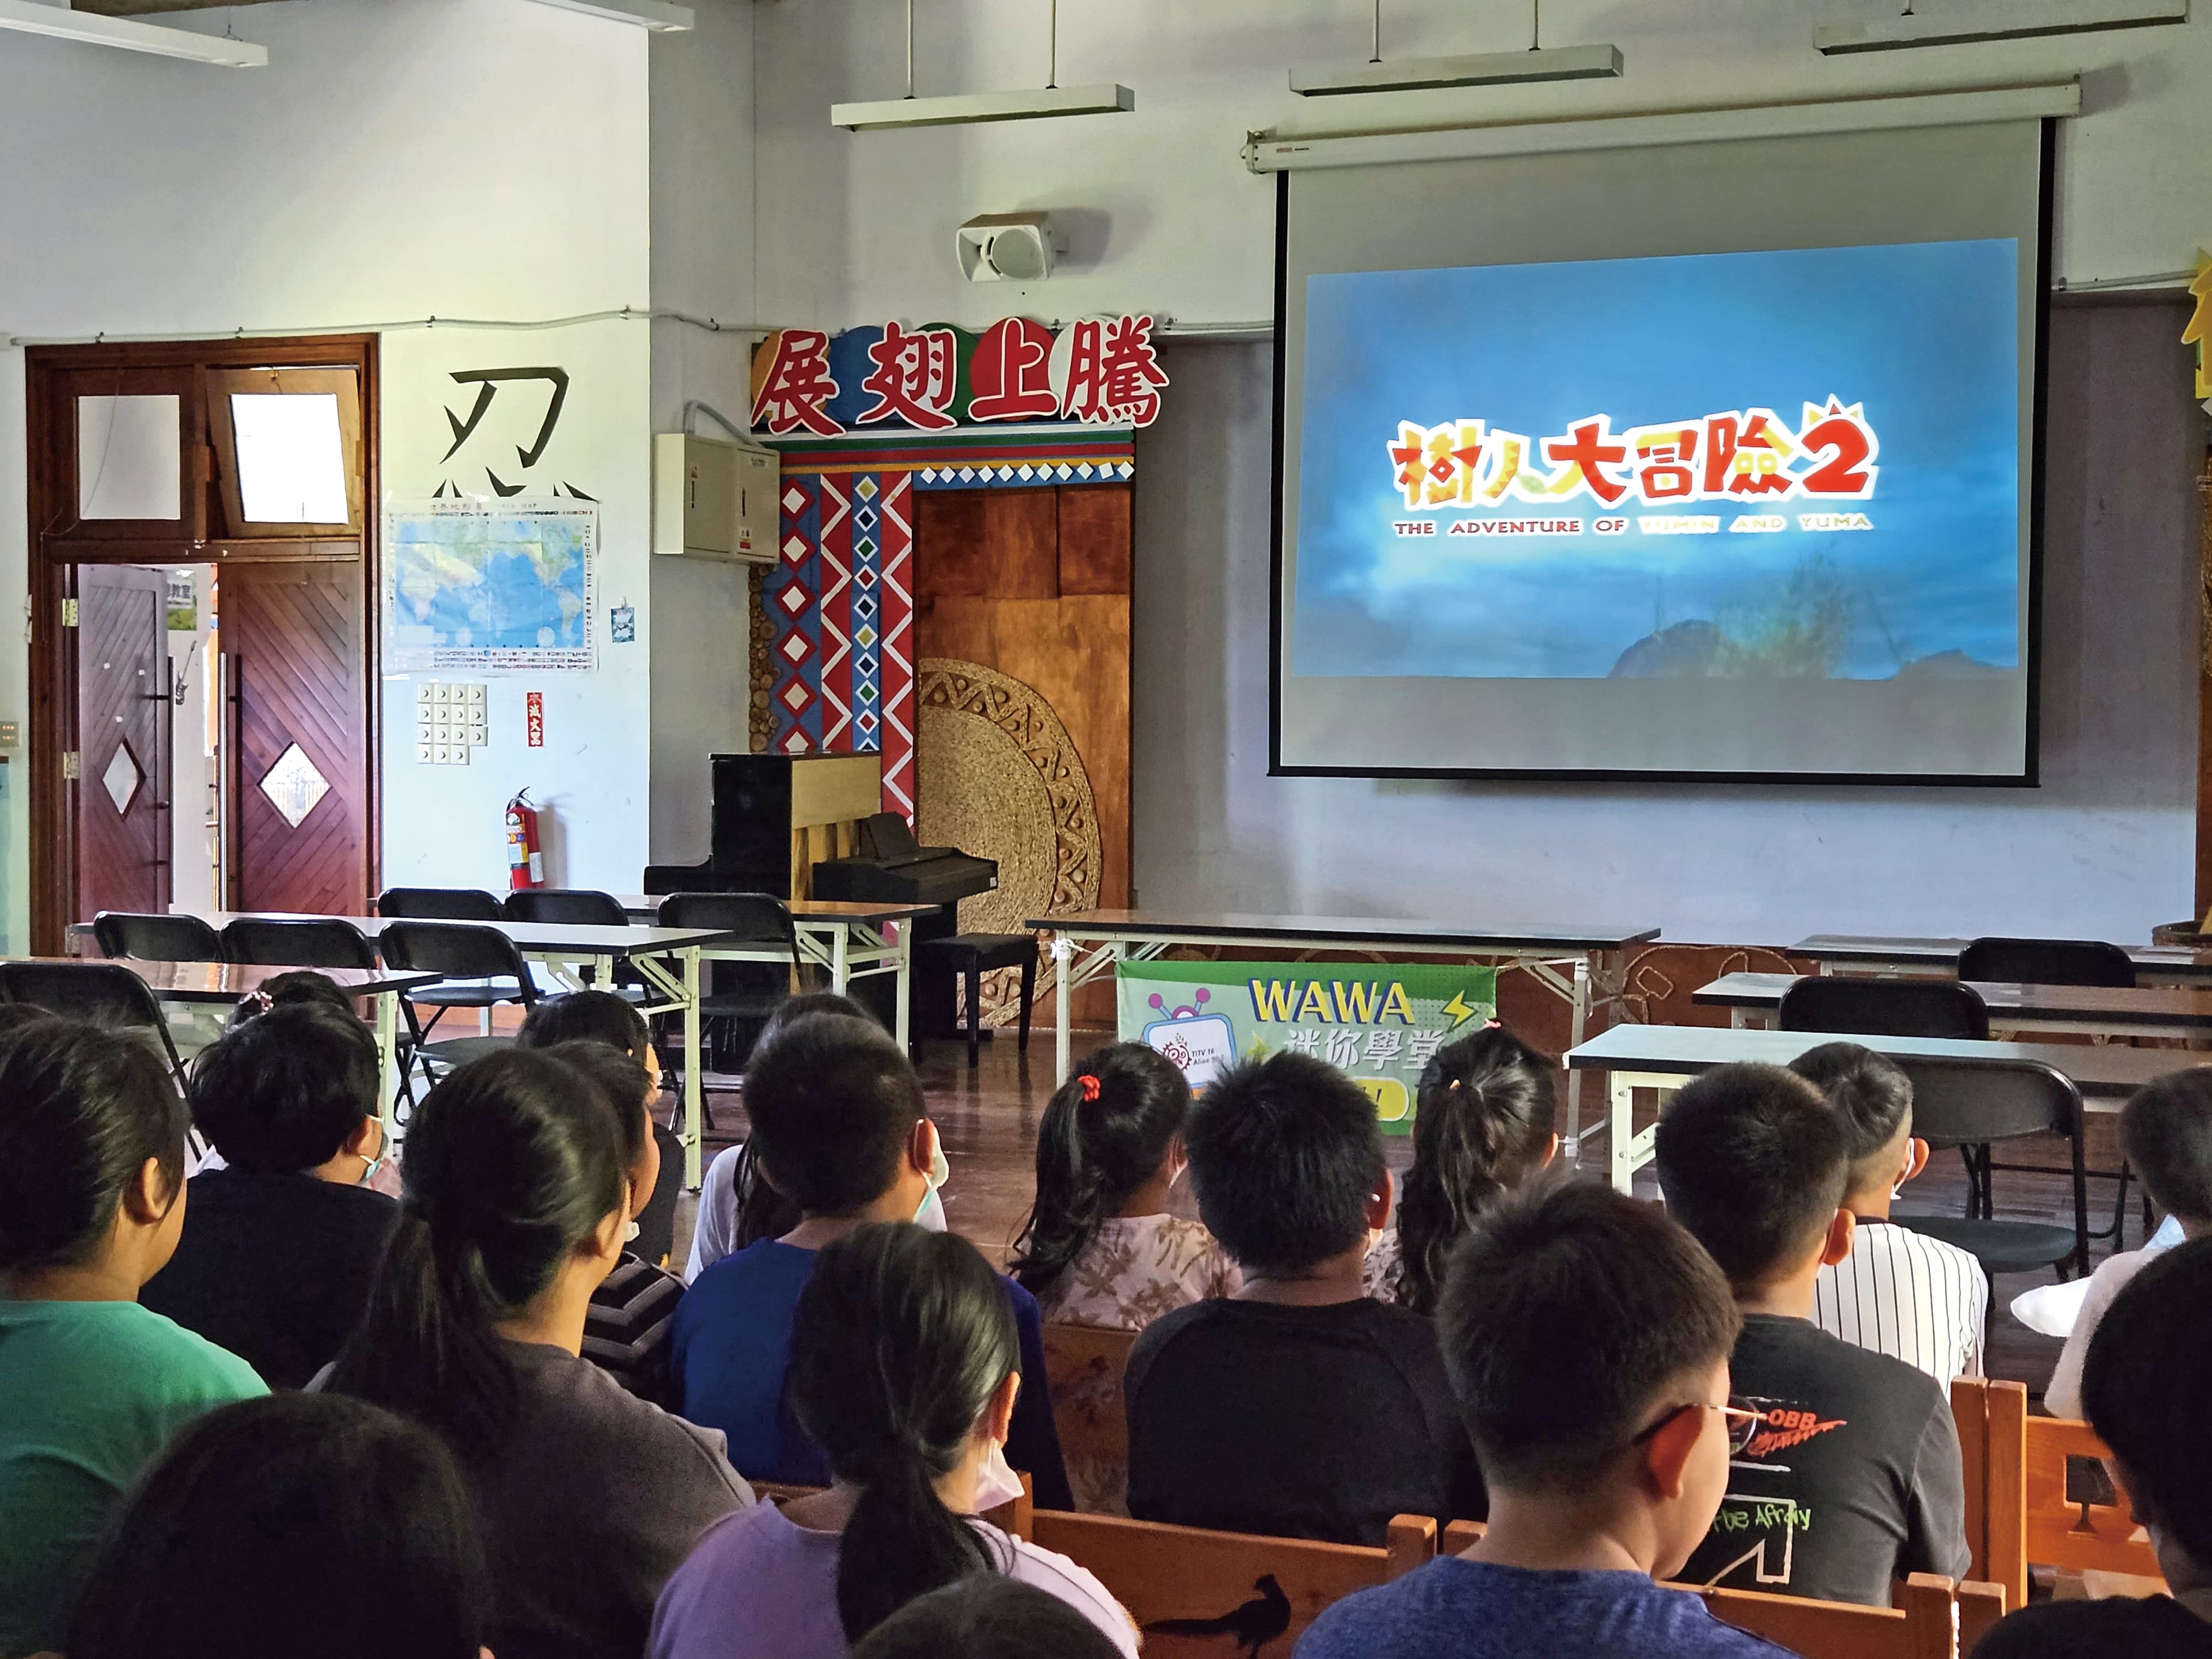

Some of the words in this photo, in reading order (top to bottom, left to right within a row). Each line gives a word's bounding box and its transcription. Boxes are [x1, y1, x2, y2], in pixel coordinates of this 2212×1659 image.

[750, 315, 1170, 438] 展翅上騰
[1395, 522, 1434, 535] THE
[1450, 521, 1581, 533] ADVENTURE
[1595, 520, 1624, 532] OF
[1735, 519, 1783, 529] AND
[1801, 517, 1869, 528] YUMA
[1248, 978, 1415, 1025] WAWA
[1192, 1049, 1206, 1058] TITV
[1283, 1028, 1446, 1070] 迷你學堂
